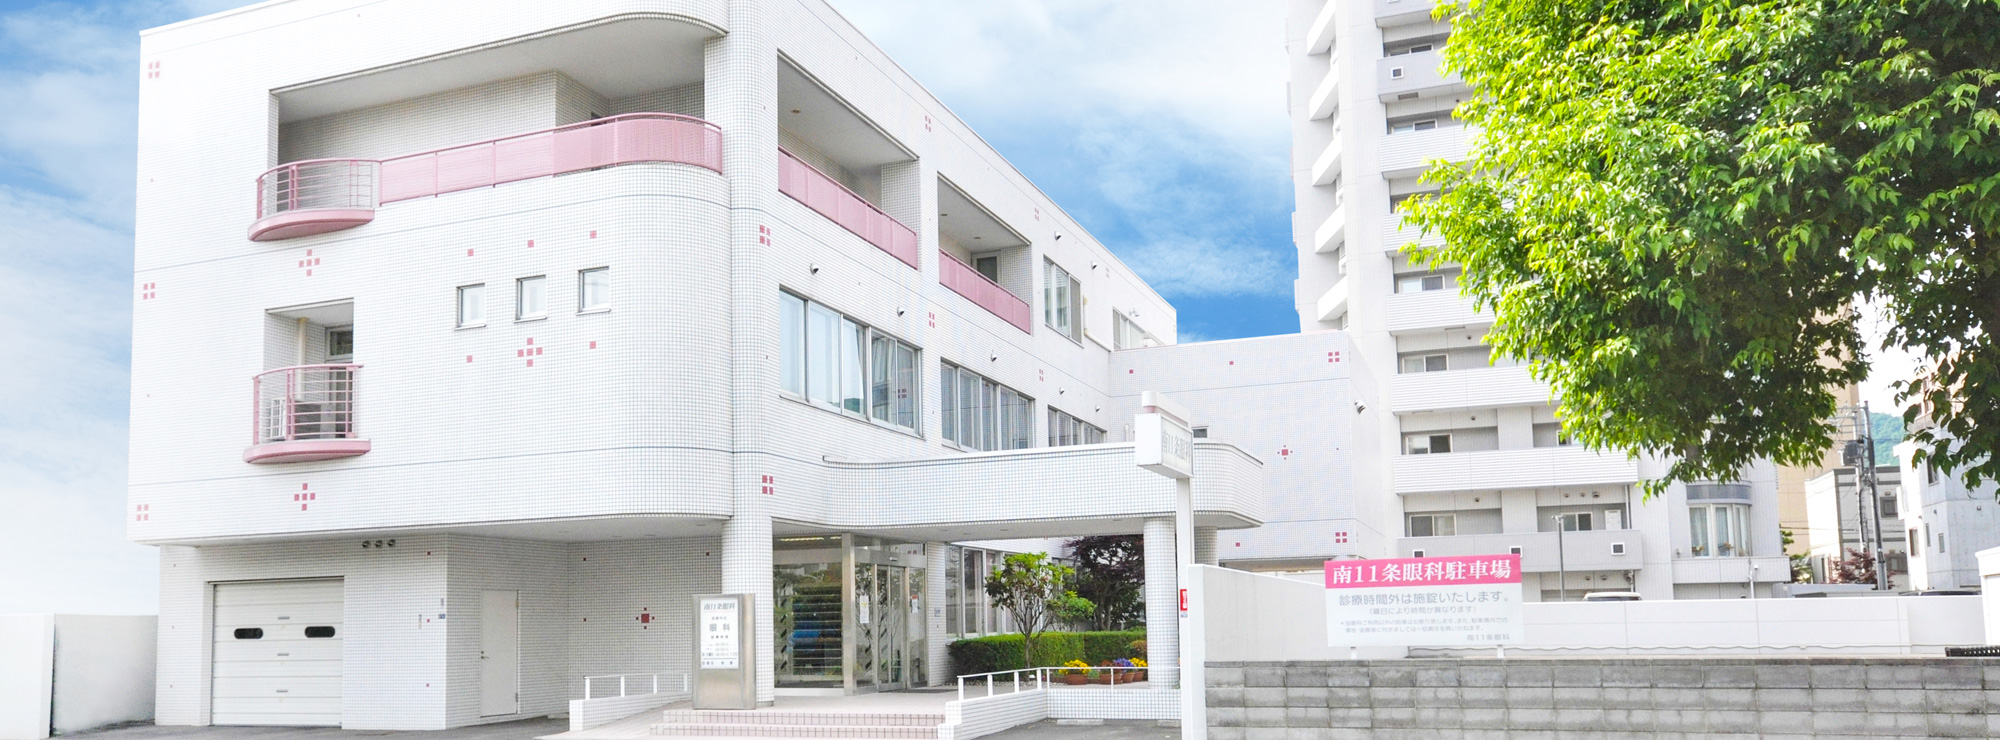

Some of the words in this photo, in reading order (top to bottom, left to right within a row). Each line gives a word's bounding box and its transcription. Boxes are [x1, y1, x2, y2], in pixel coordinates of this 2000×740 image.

[1162, 429, 1191, 464] 南11条眼科
[1333, 559, 1511, 584] 南11条眼科駐車場
[704, 602, 736, 610] 南11条眼科
[1339, 591, 1508, 606] 診療時間外は施錠いたします。
[1466, 633, 1510, 641] 南11条眼科
